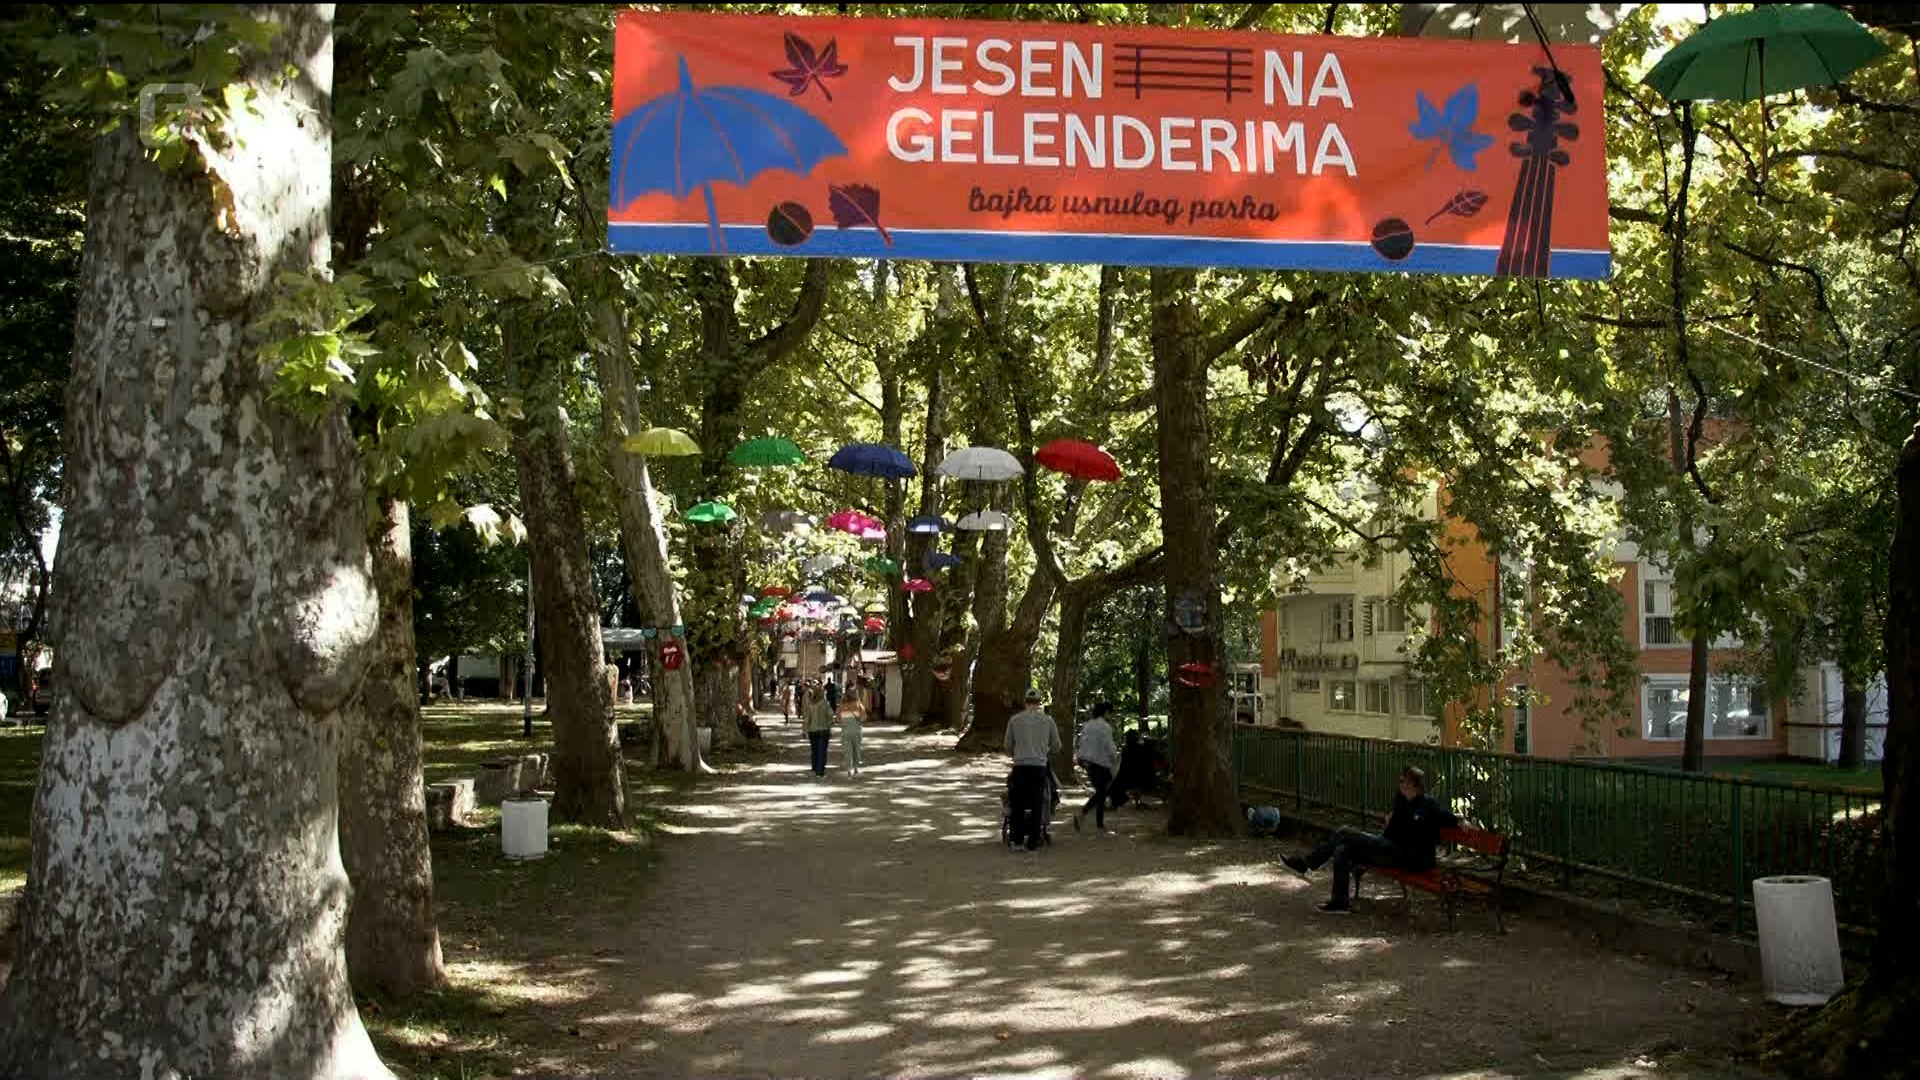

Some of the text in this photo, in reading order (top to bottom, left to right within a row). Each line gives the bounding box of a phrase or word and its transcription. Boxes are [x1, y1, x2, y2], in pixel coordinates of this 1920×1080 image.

[888, 36, 1353, 108] JESEN NA
[886, 107, 1357, 176] GELENDERIMA
[968, 186, 1280, 224] bajka usnulog parka
